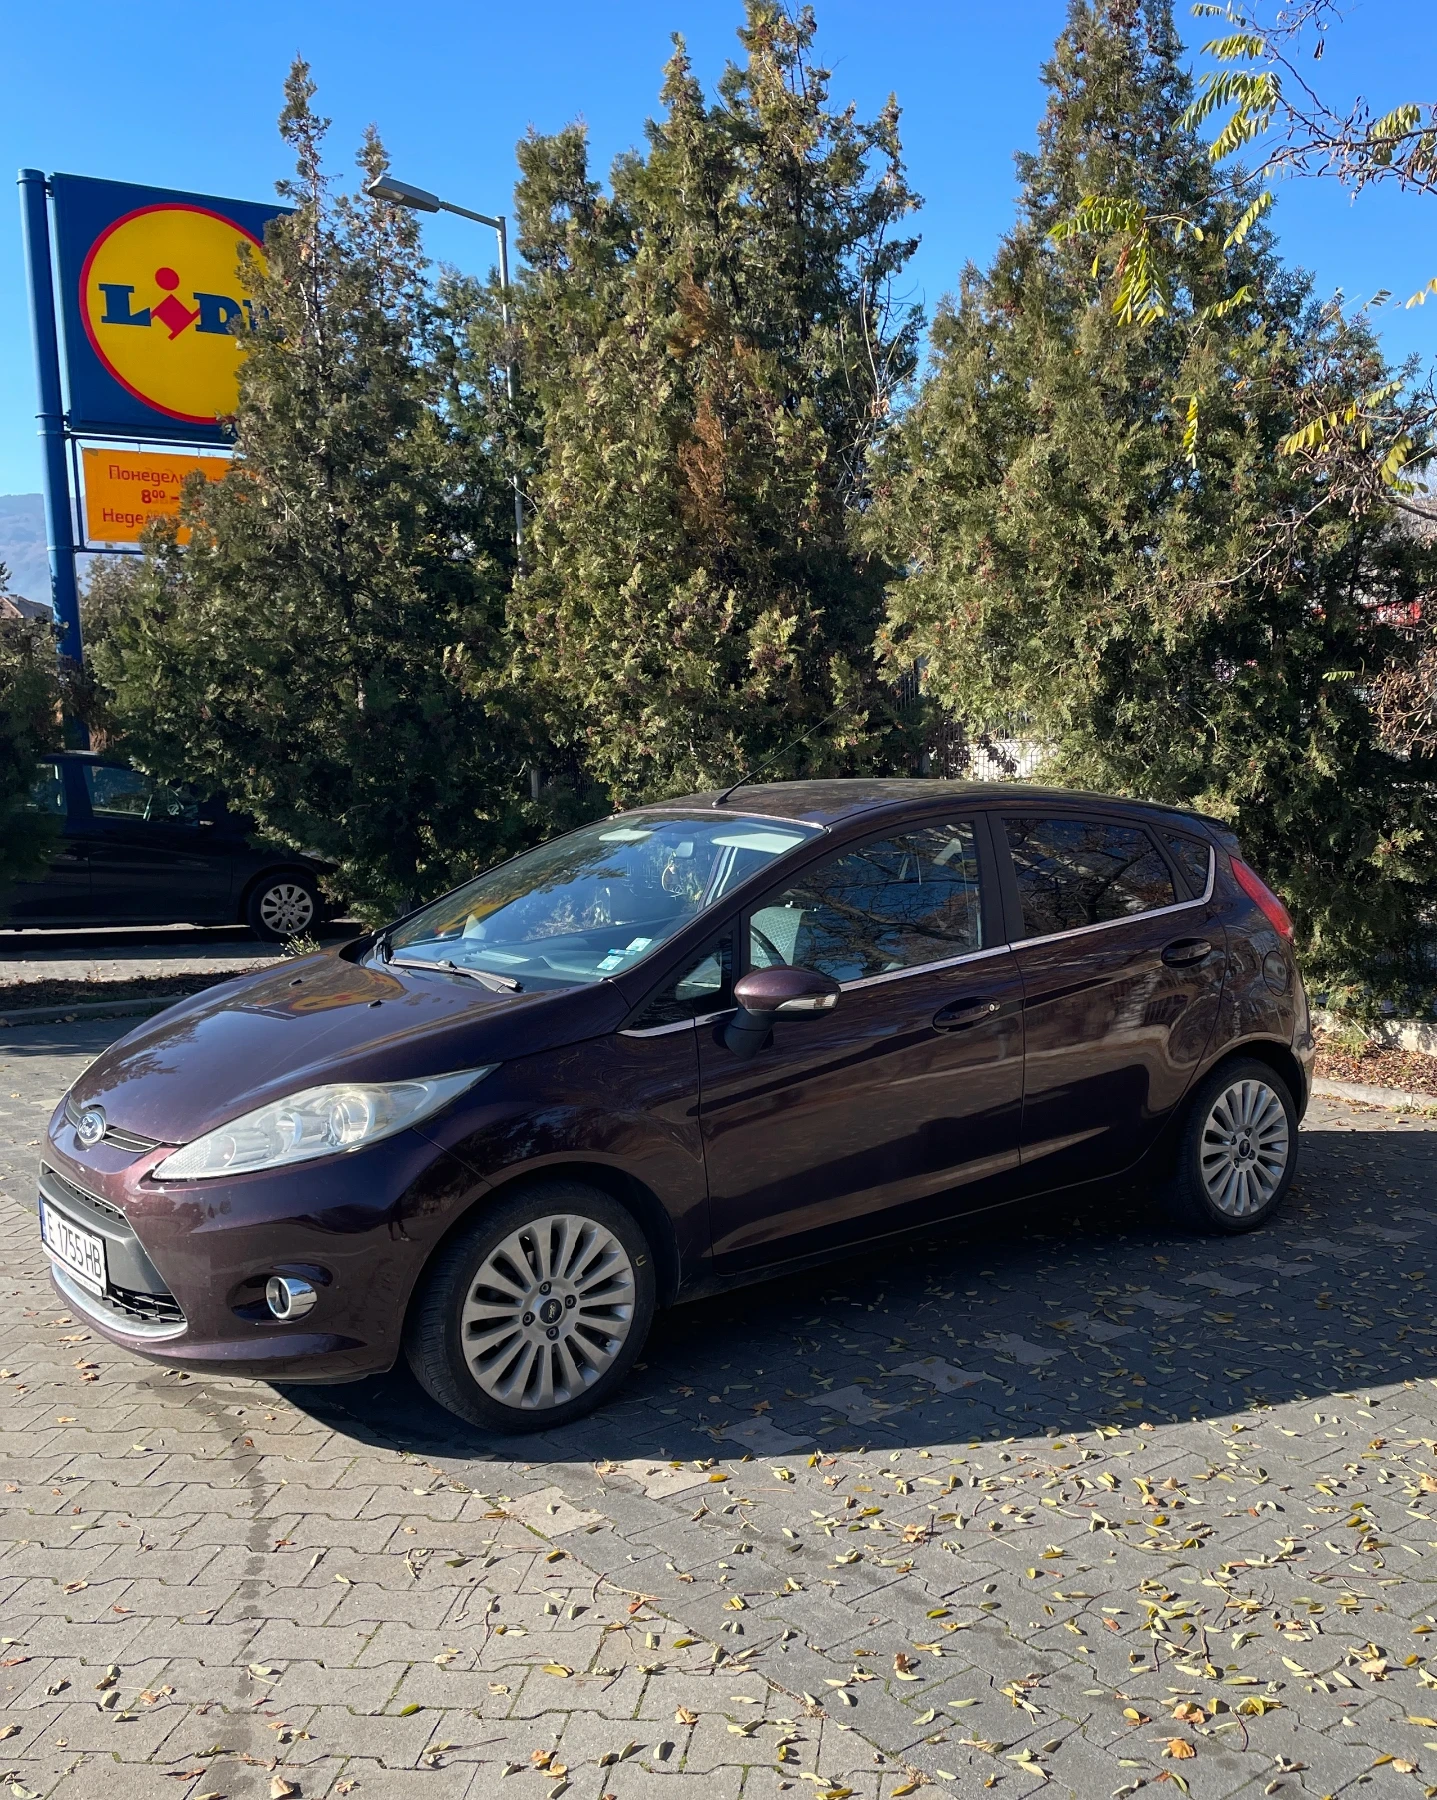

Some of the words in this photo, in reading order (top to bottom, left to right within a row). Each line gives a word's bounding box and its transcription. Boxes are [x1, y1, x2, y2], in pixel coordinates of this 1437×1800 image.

[47, 1210, 55, 1245] E
[58, 1221, 83, 1267] 1755
[84, 1238, 102, 1279] HB
